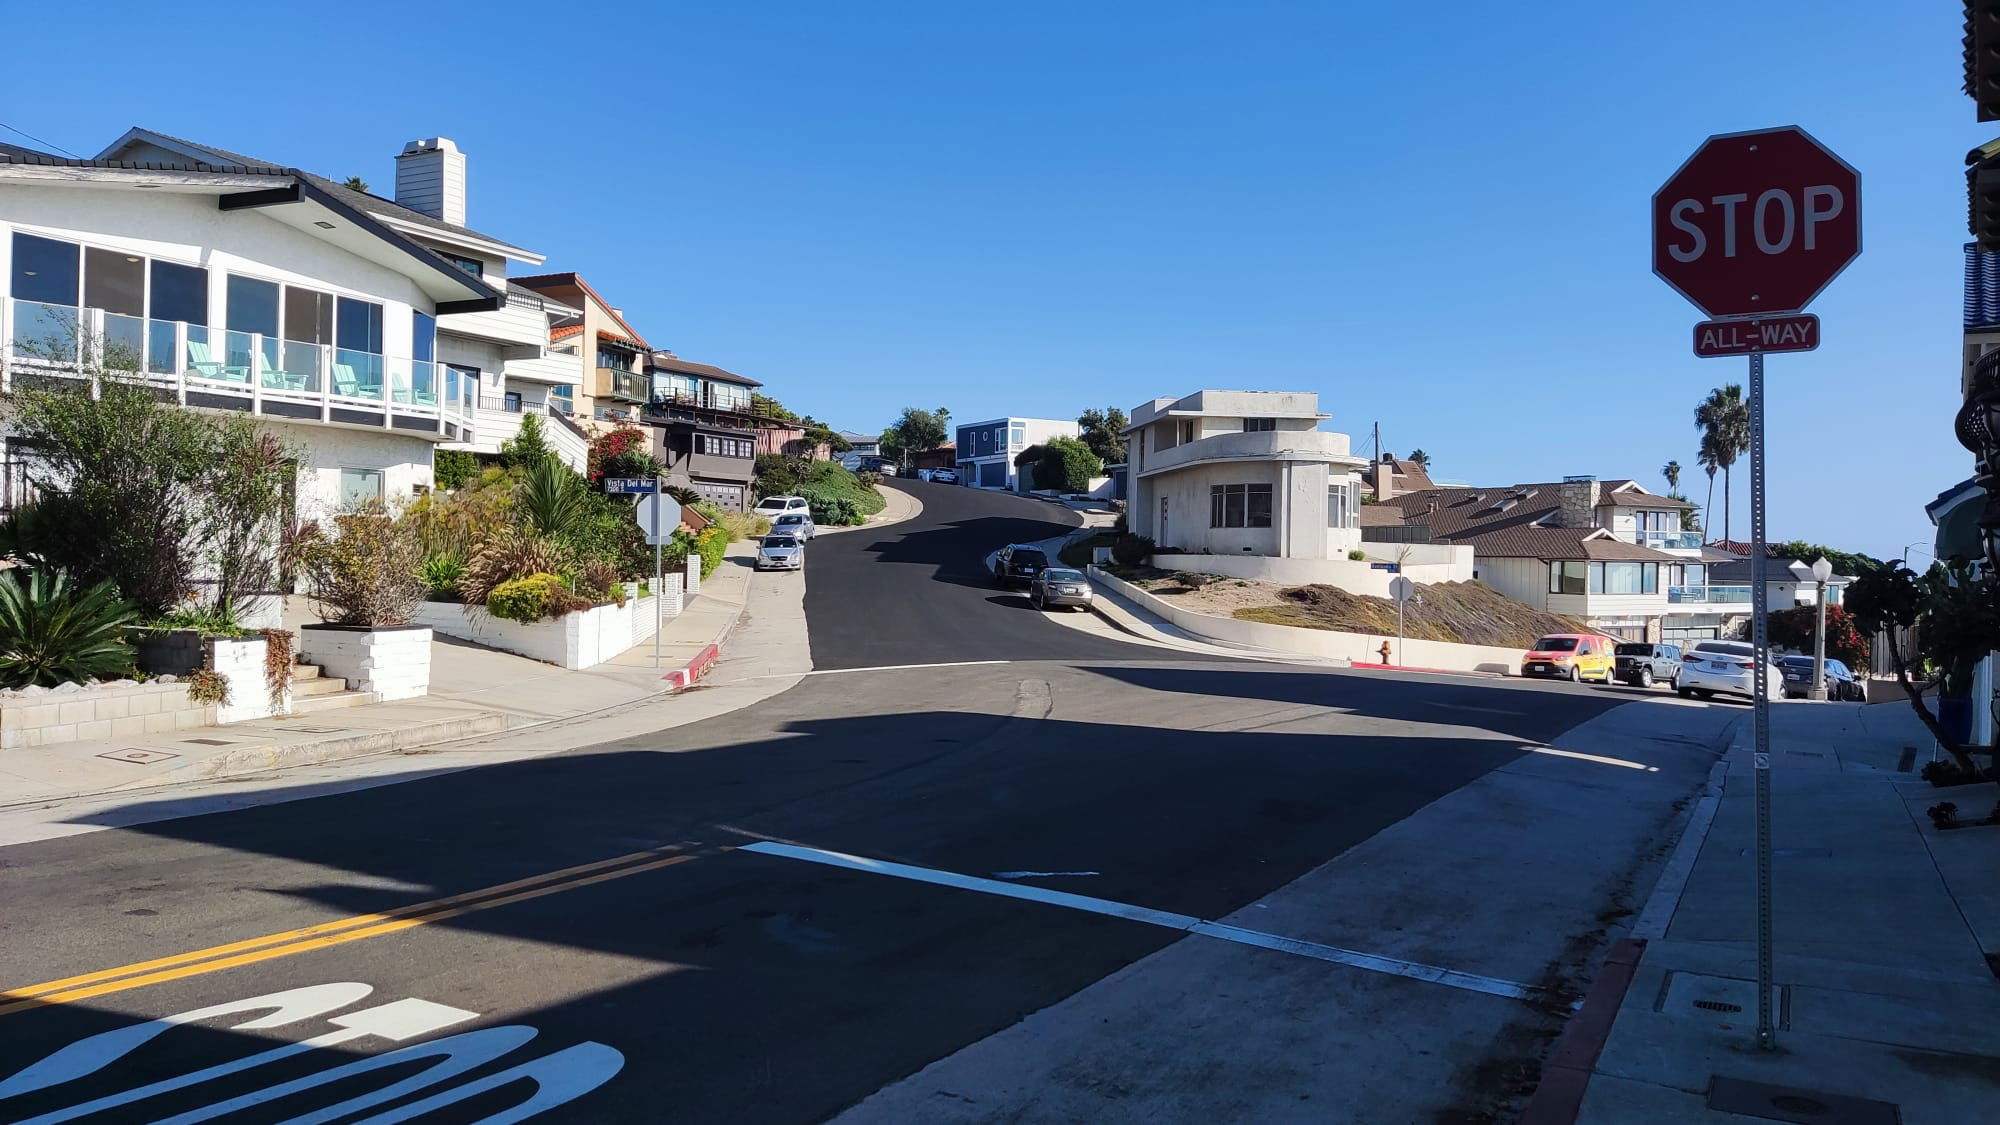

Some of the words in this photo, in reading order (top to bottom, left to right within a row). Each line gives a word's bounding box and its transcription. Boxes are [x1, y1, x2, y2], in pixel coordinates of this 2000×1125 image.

[1668, 184, 1844, 263] STOP
[1700, 322, 1812, 350] ALL-WAY
[607, 479, 625, 487] Vista
[627, 479, 638, 487] Del
[641, 479, 653, 487] Mar
